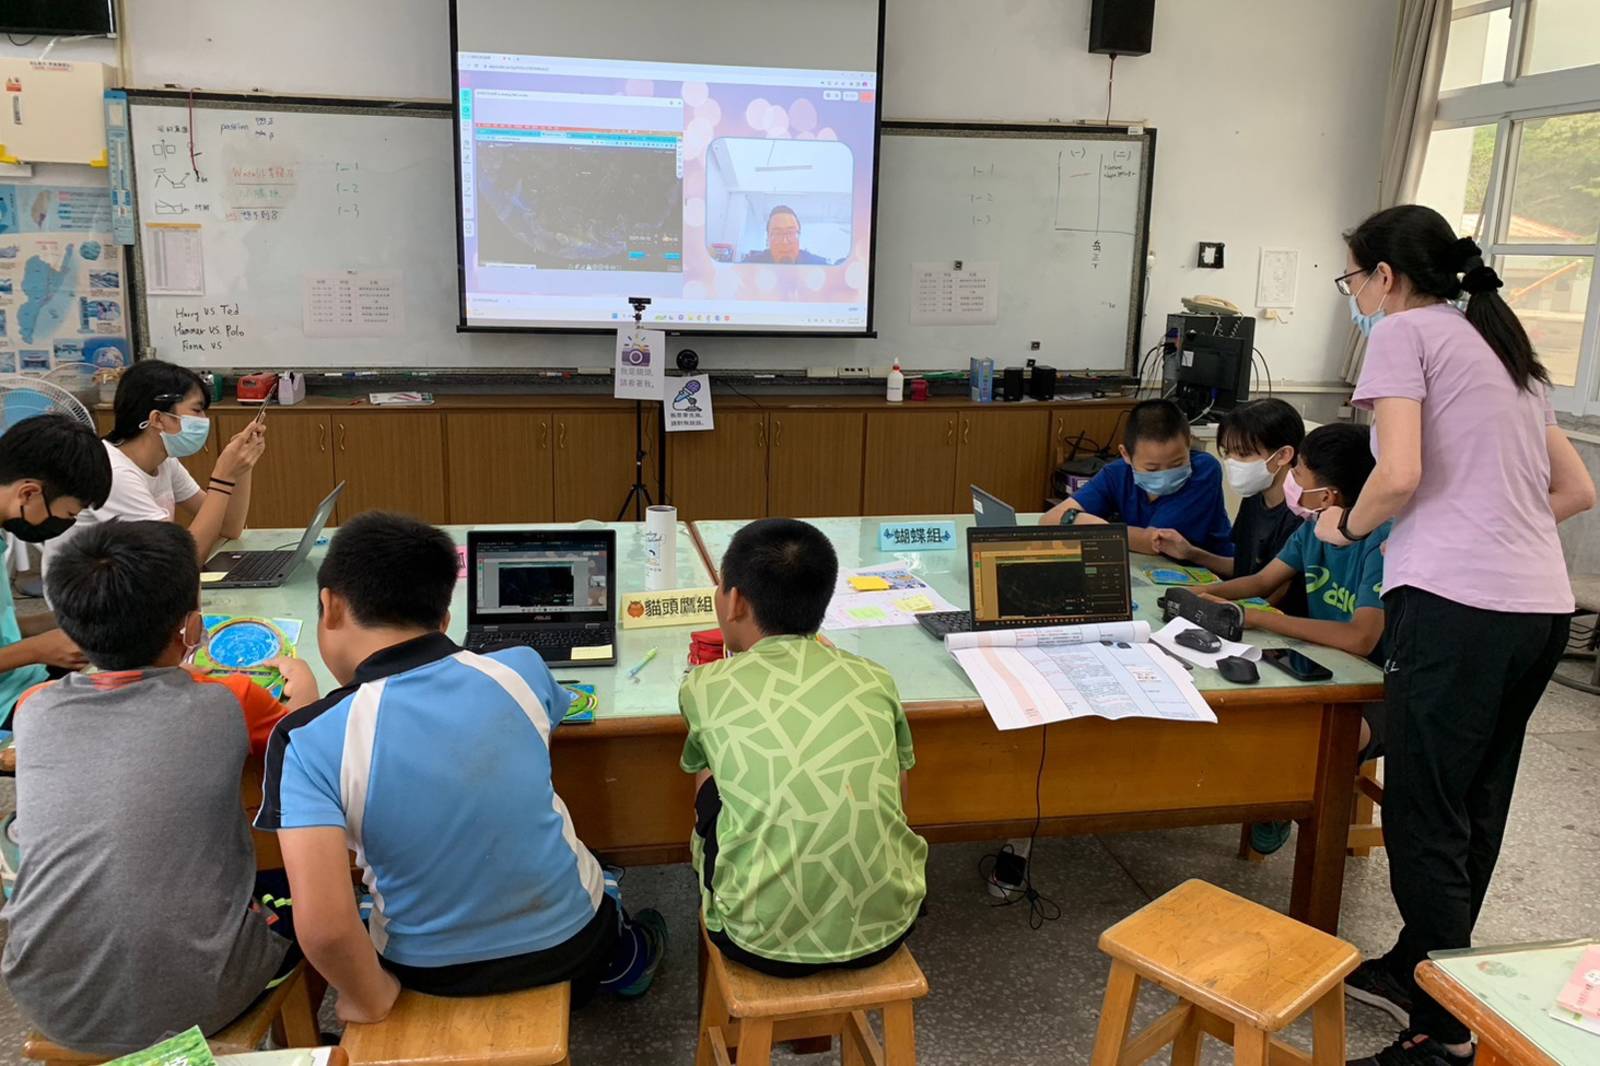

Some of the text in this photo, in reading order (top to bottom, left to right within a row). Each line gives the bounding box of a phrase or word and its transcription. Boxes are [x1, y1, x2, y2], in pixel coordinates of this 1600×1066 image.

[894, 527, 942, 544] 蝴蝶組
[645, 595, 713, 617] 貓頭鷹組
[1322, 581, 1356, 615] asic
